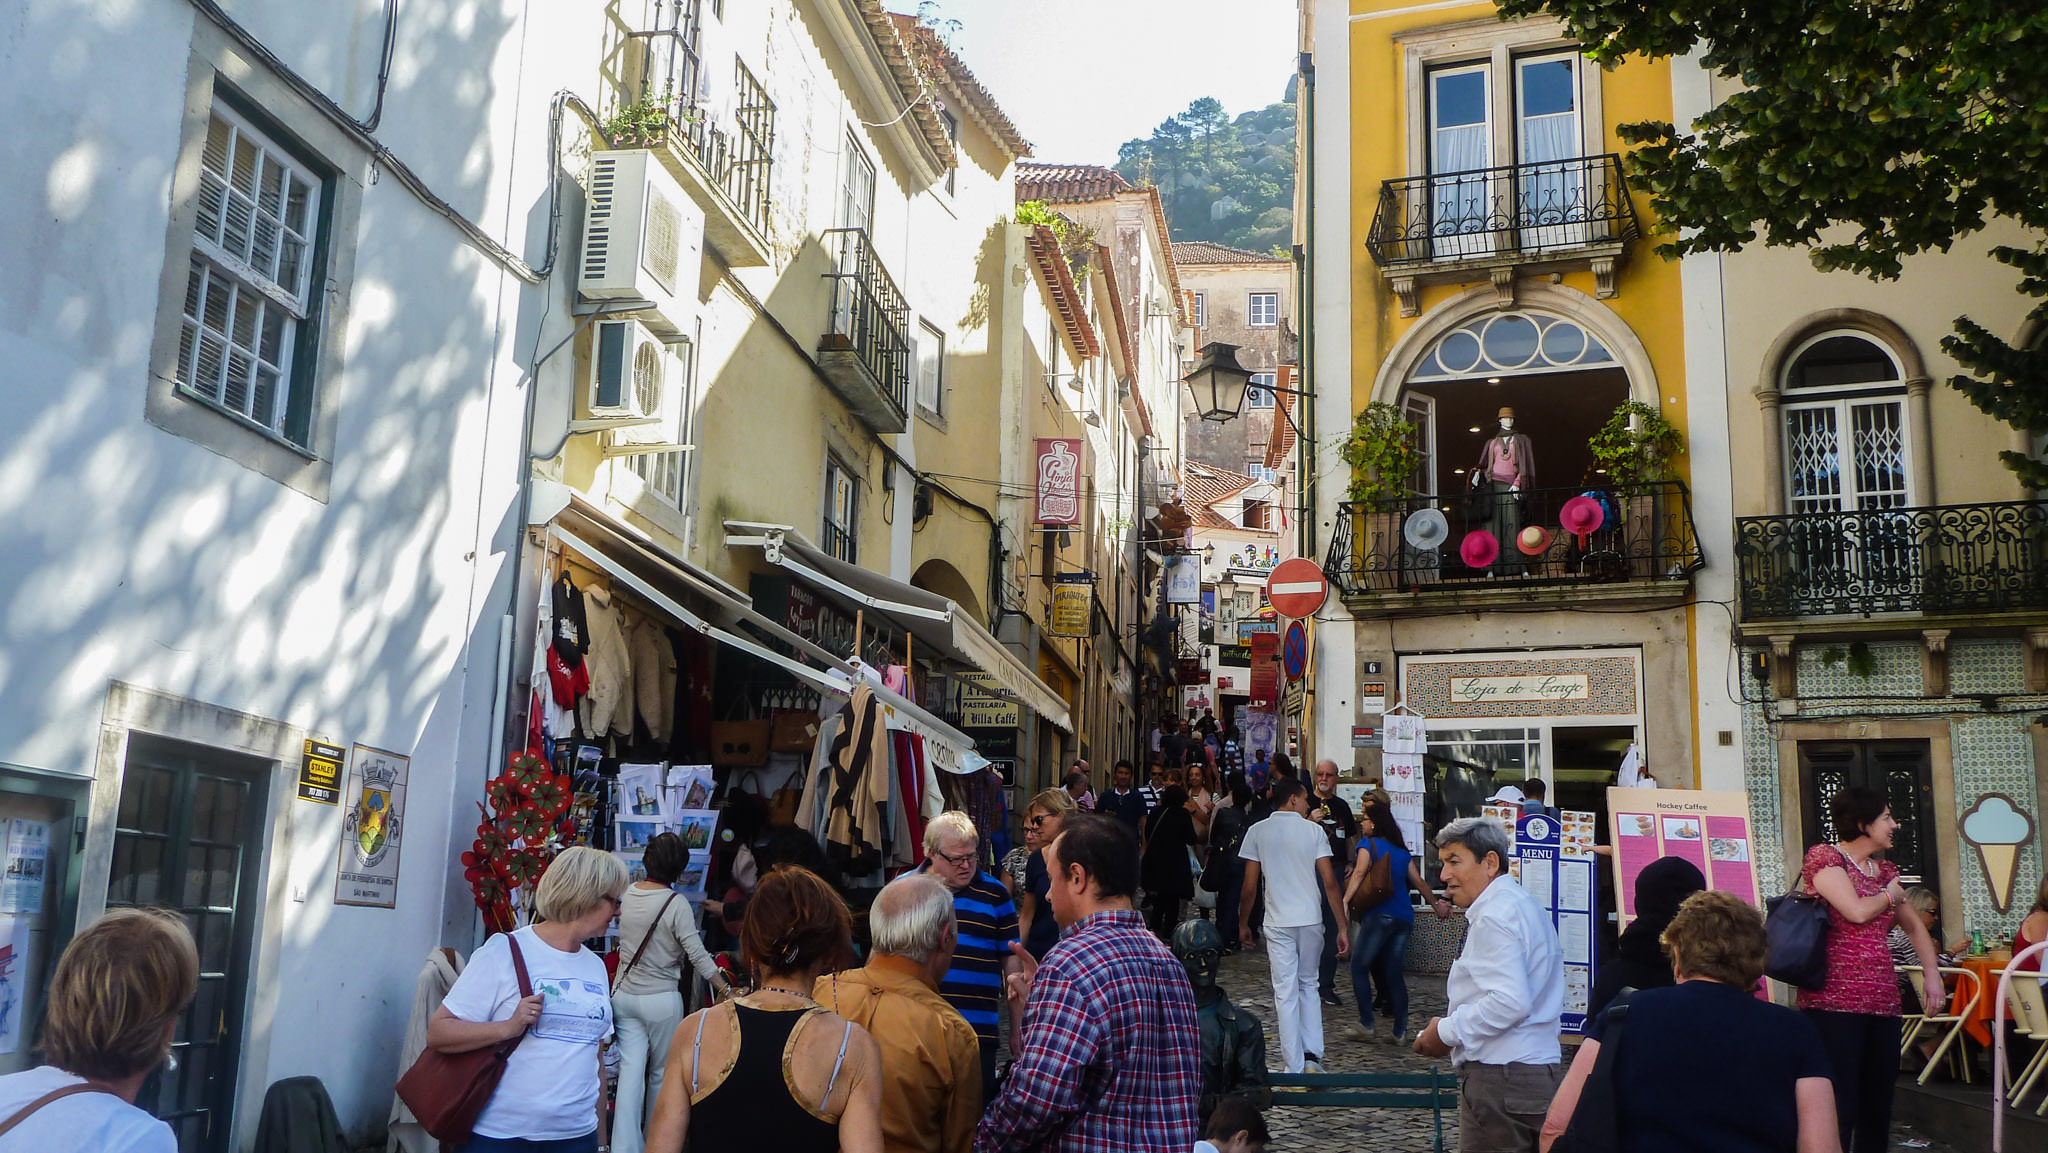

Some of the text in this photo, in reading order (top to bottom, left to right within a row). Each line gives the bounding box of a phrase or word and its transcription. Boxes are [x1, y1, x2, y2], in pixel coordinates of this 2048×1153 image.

[1254, 559, 1276, 568] CASA
[1369, 662, 1376, 674] 6
[1454, 676, 1583, 701] Loja do Largo
[971, 712, 1017, 725] Villa Caffé
[1861, 724, 1867, 736] 7
[311, 763, 335, 775] STANLEY
[1656, 802, 1682, 810] Hockey
[1522, 848, 1553, 859] MENU
